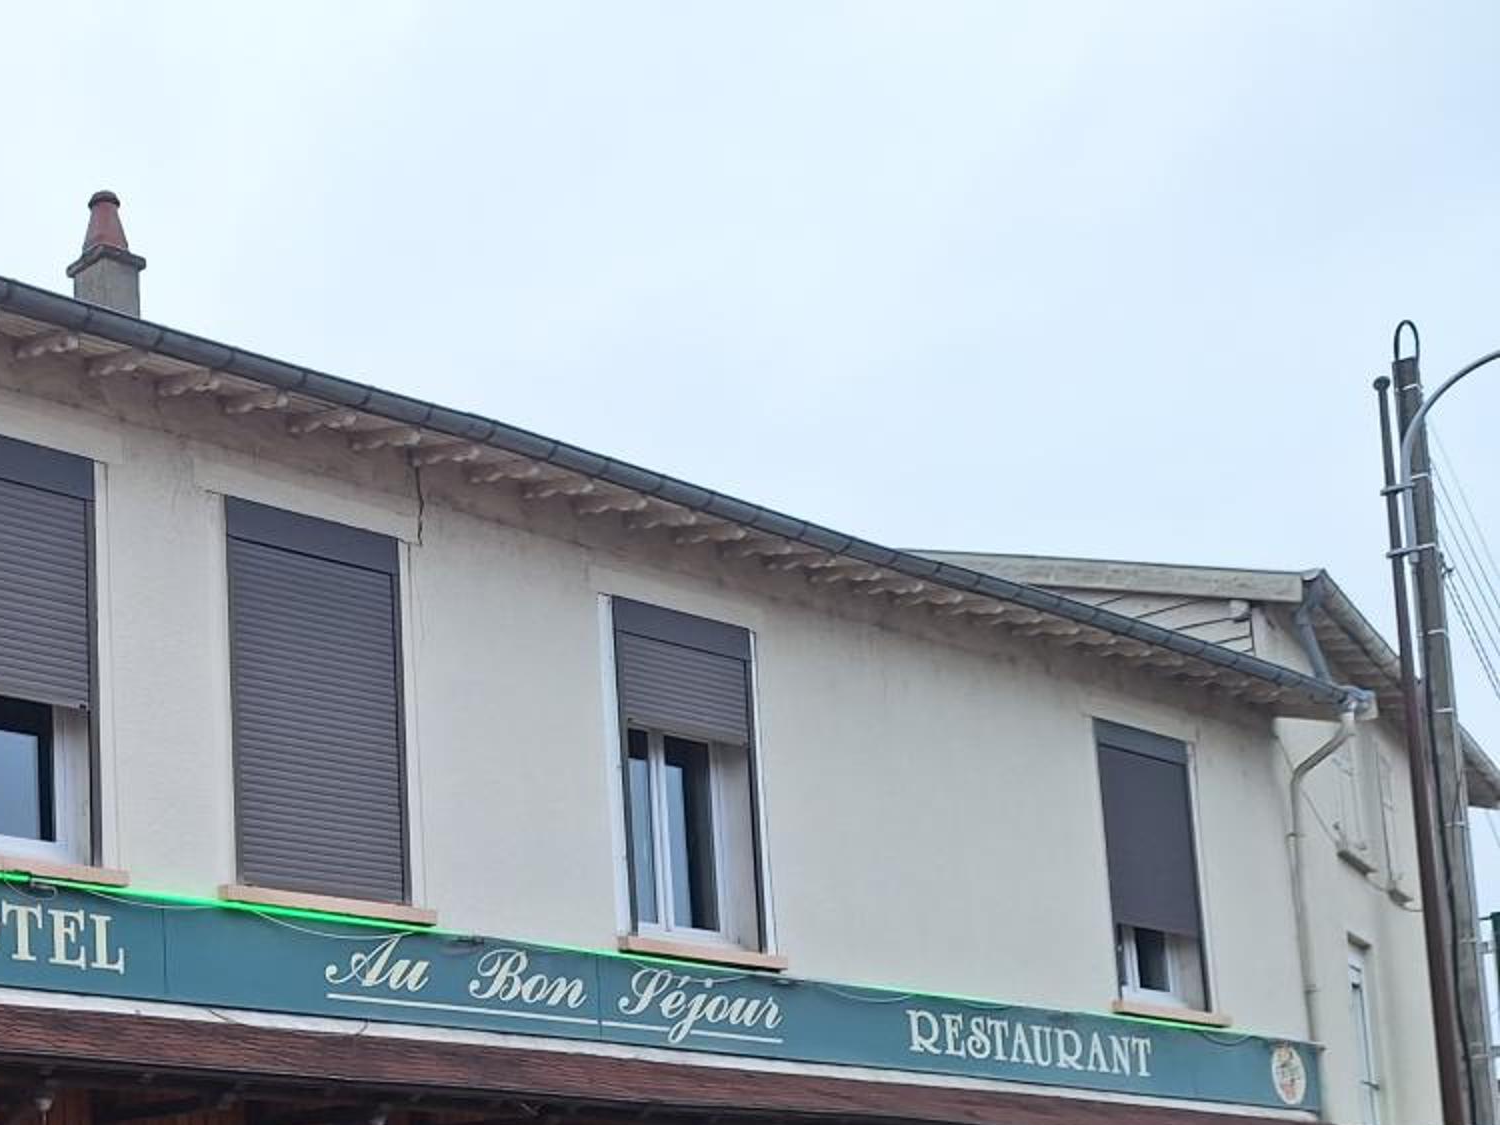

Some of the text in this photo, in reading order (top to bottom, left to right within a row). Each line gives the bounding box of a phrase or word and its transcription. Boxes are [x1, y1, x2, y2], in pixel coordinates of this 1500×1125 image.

[325, 934, 783, 1044] Au Bon Séjour
[905, 1009, 1152, 1077] RESTAURANT
